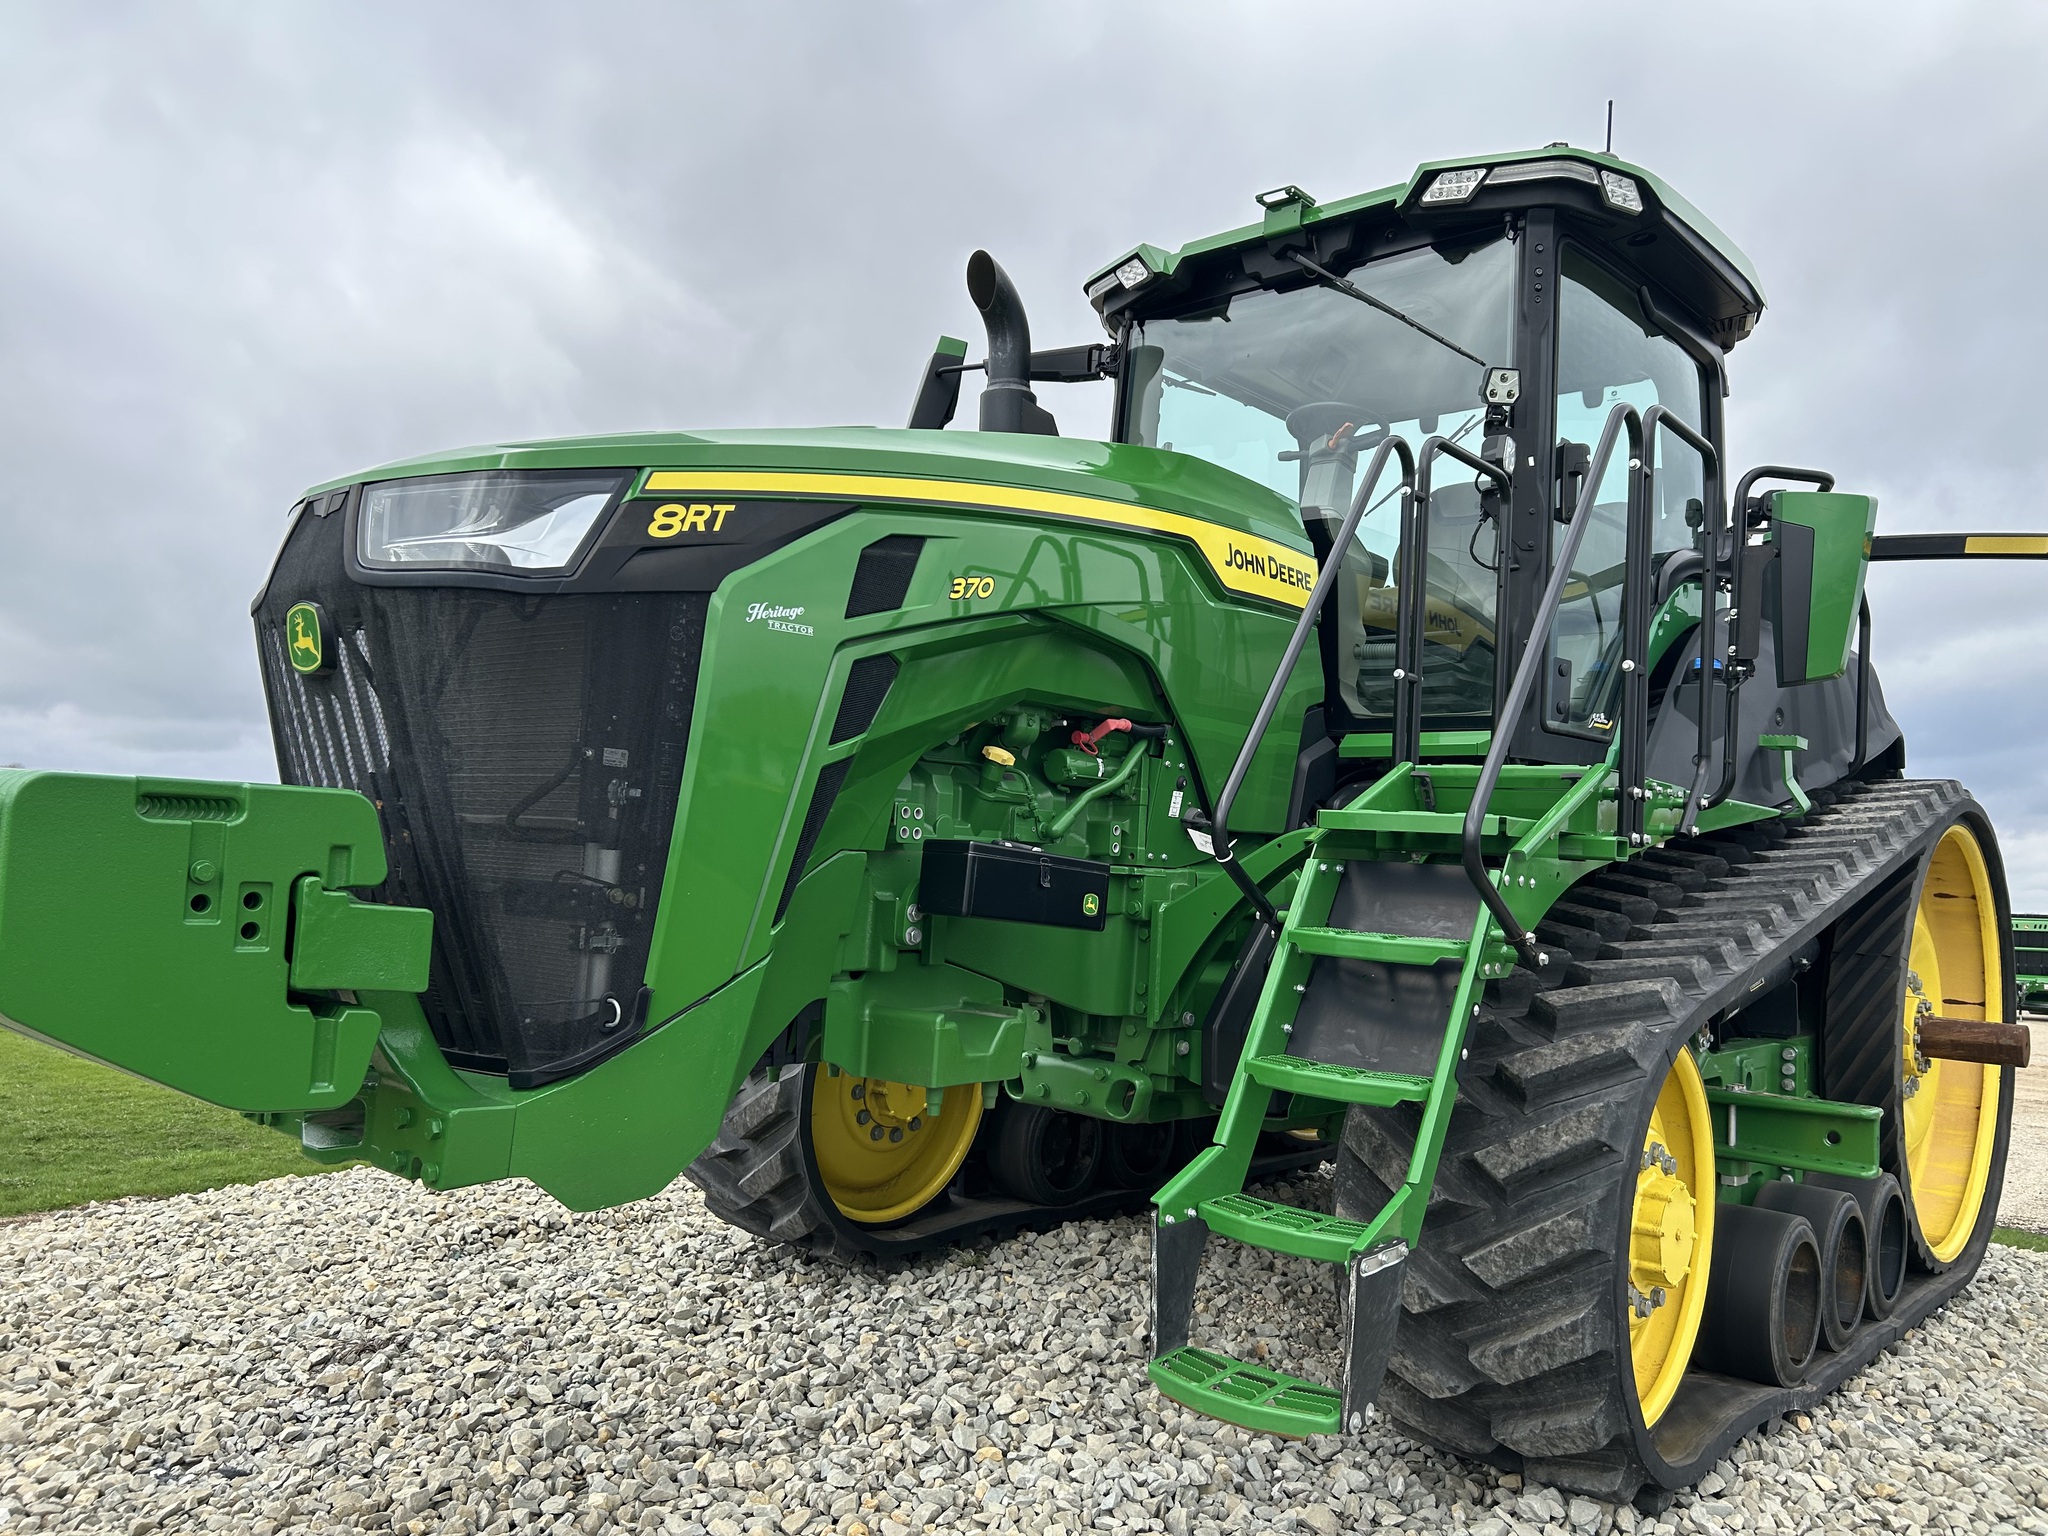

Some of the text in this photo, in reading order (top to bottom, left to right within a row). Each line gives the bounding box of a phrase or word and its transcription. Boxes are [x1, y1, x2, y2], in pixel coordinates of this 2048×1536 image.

[647, 503, 736, 538] 8RT
[1225, 543, 1312, 592] JOHN DEERE
[949, 576, 995, 600] 370
[746, 602, 805, 623] Heritage
[768, 621, 814, 635] TRACTOR
